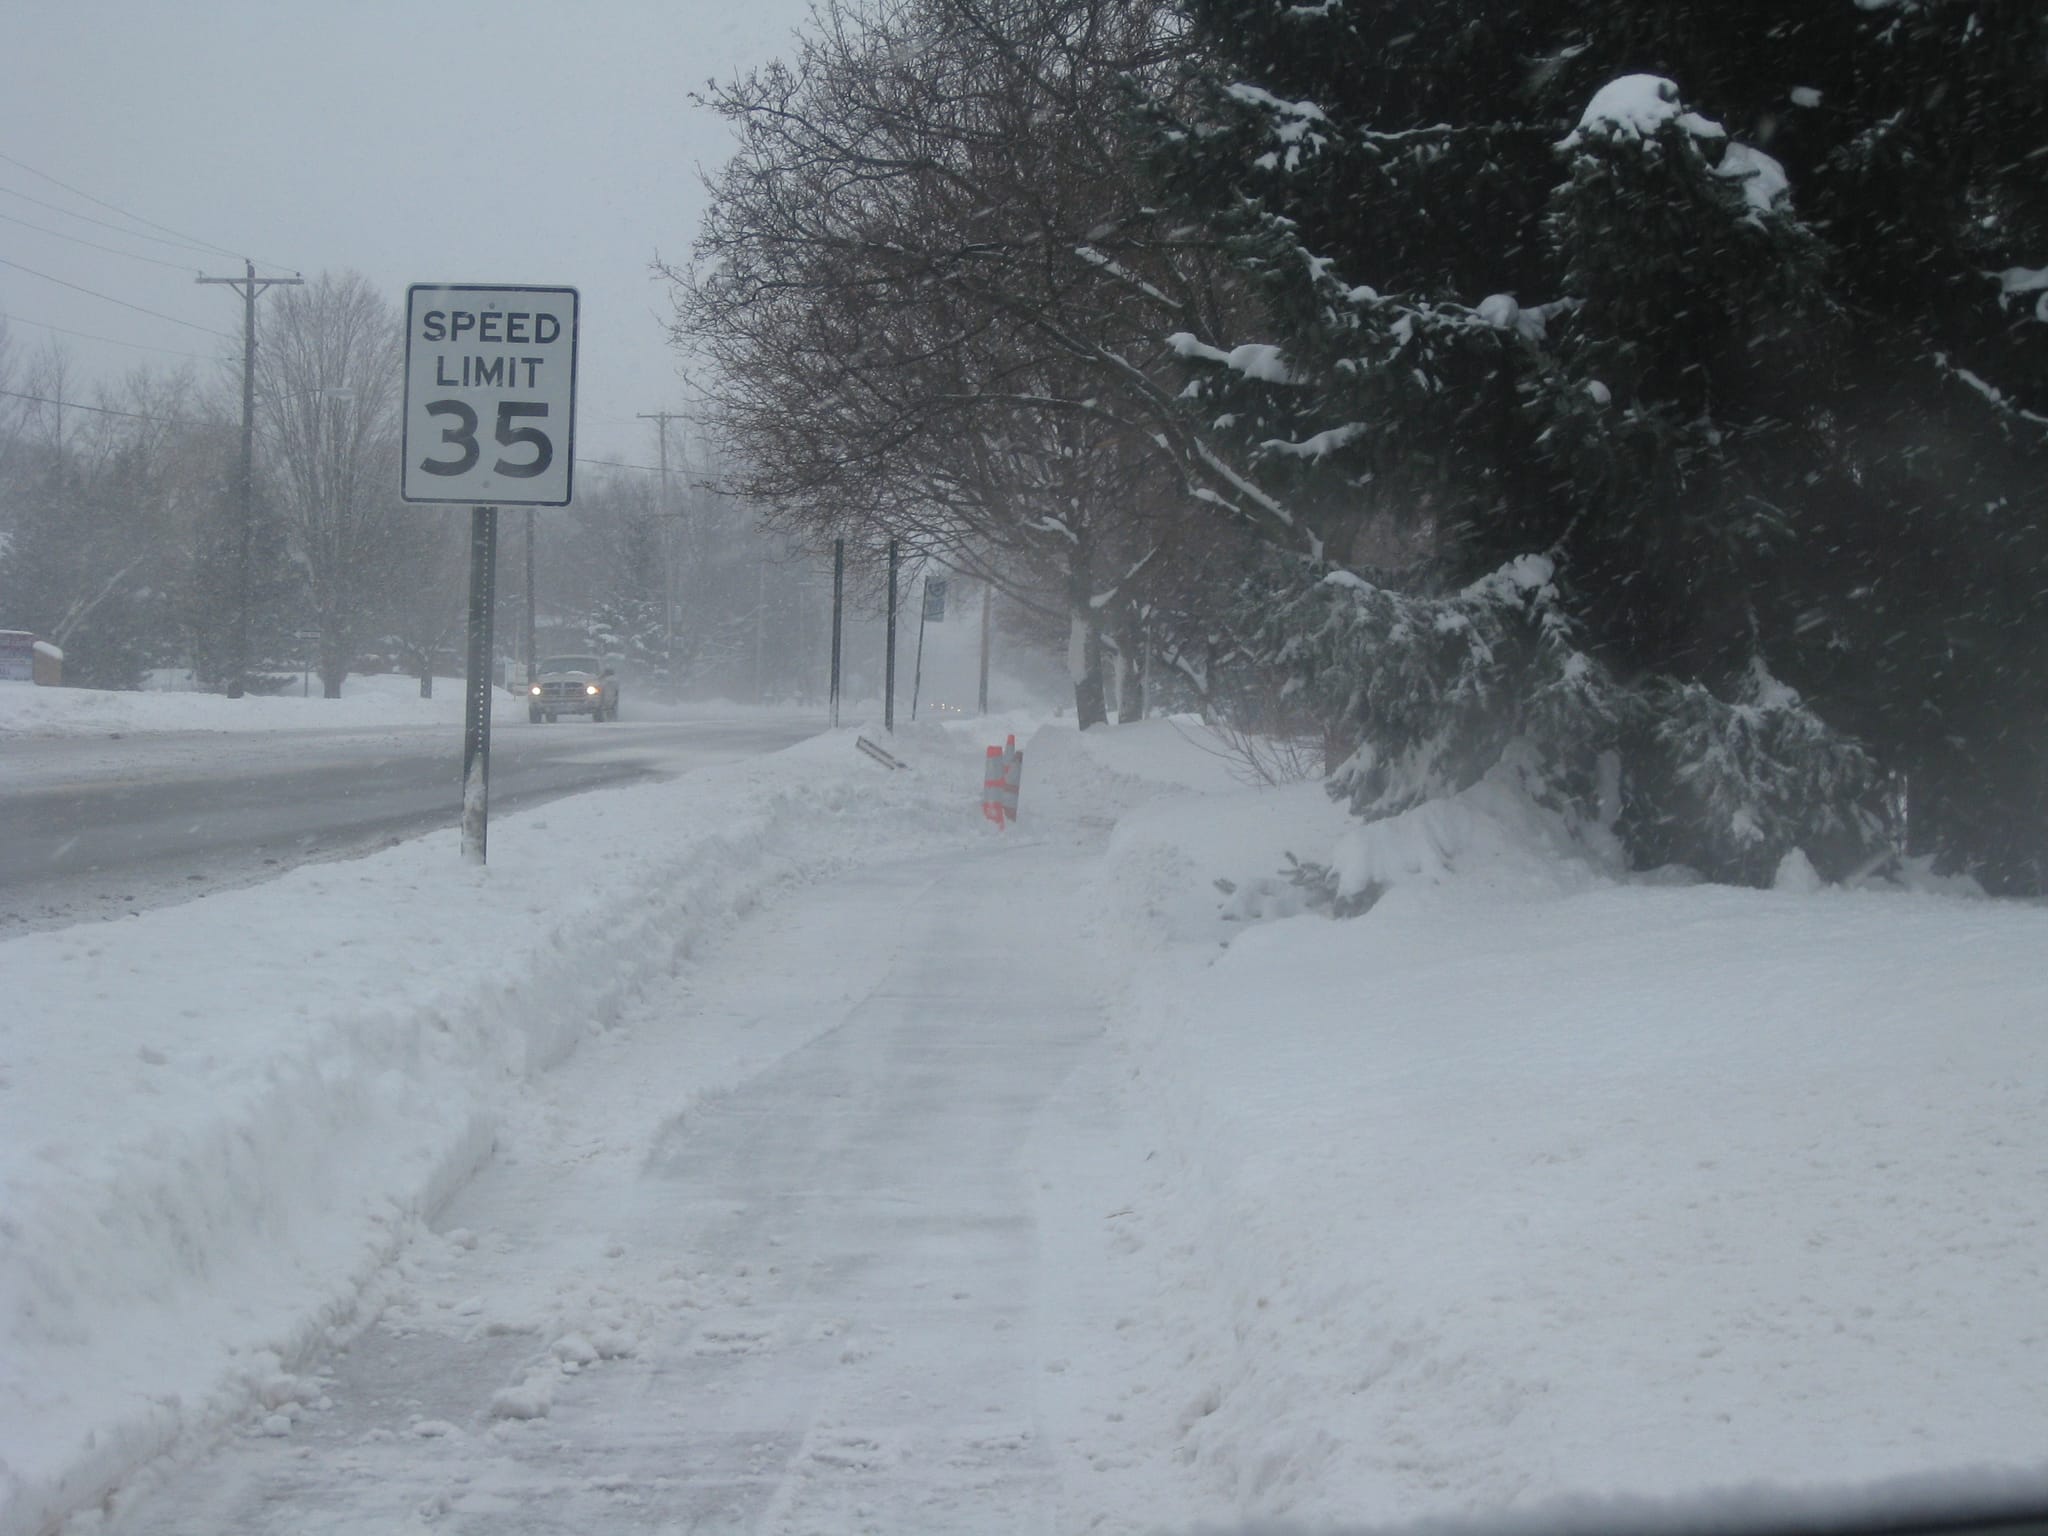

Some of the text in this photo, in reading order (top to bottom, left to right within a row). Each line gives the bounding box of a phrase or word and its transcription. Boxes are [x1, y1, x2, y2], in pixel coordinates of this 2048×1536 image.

[422, 310, 561, 344] SPEED
[436, 355, 545, 388] LIMIT
[419, 399, 553, 478] 35
